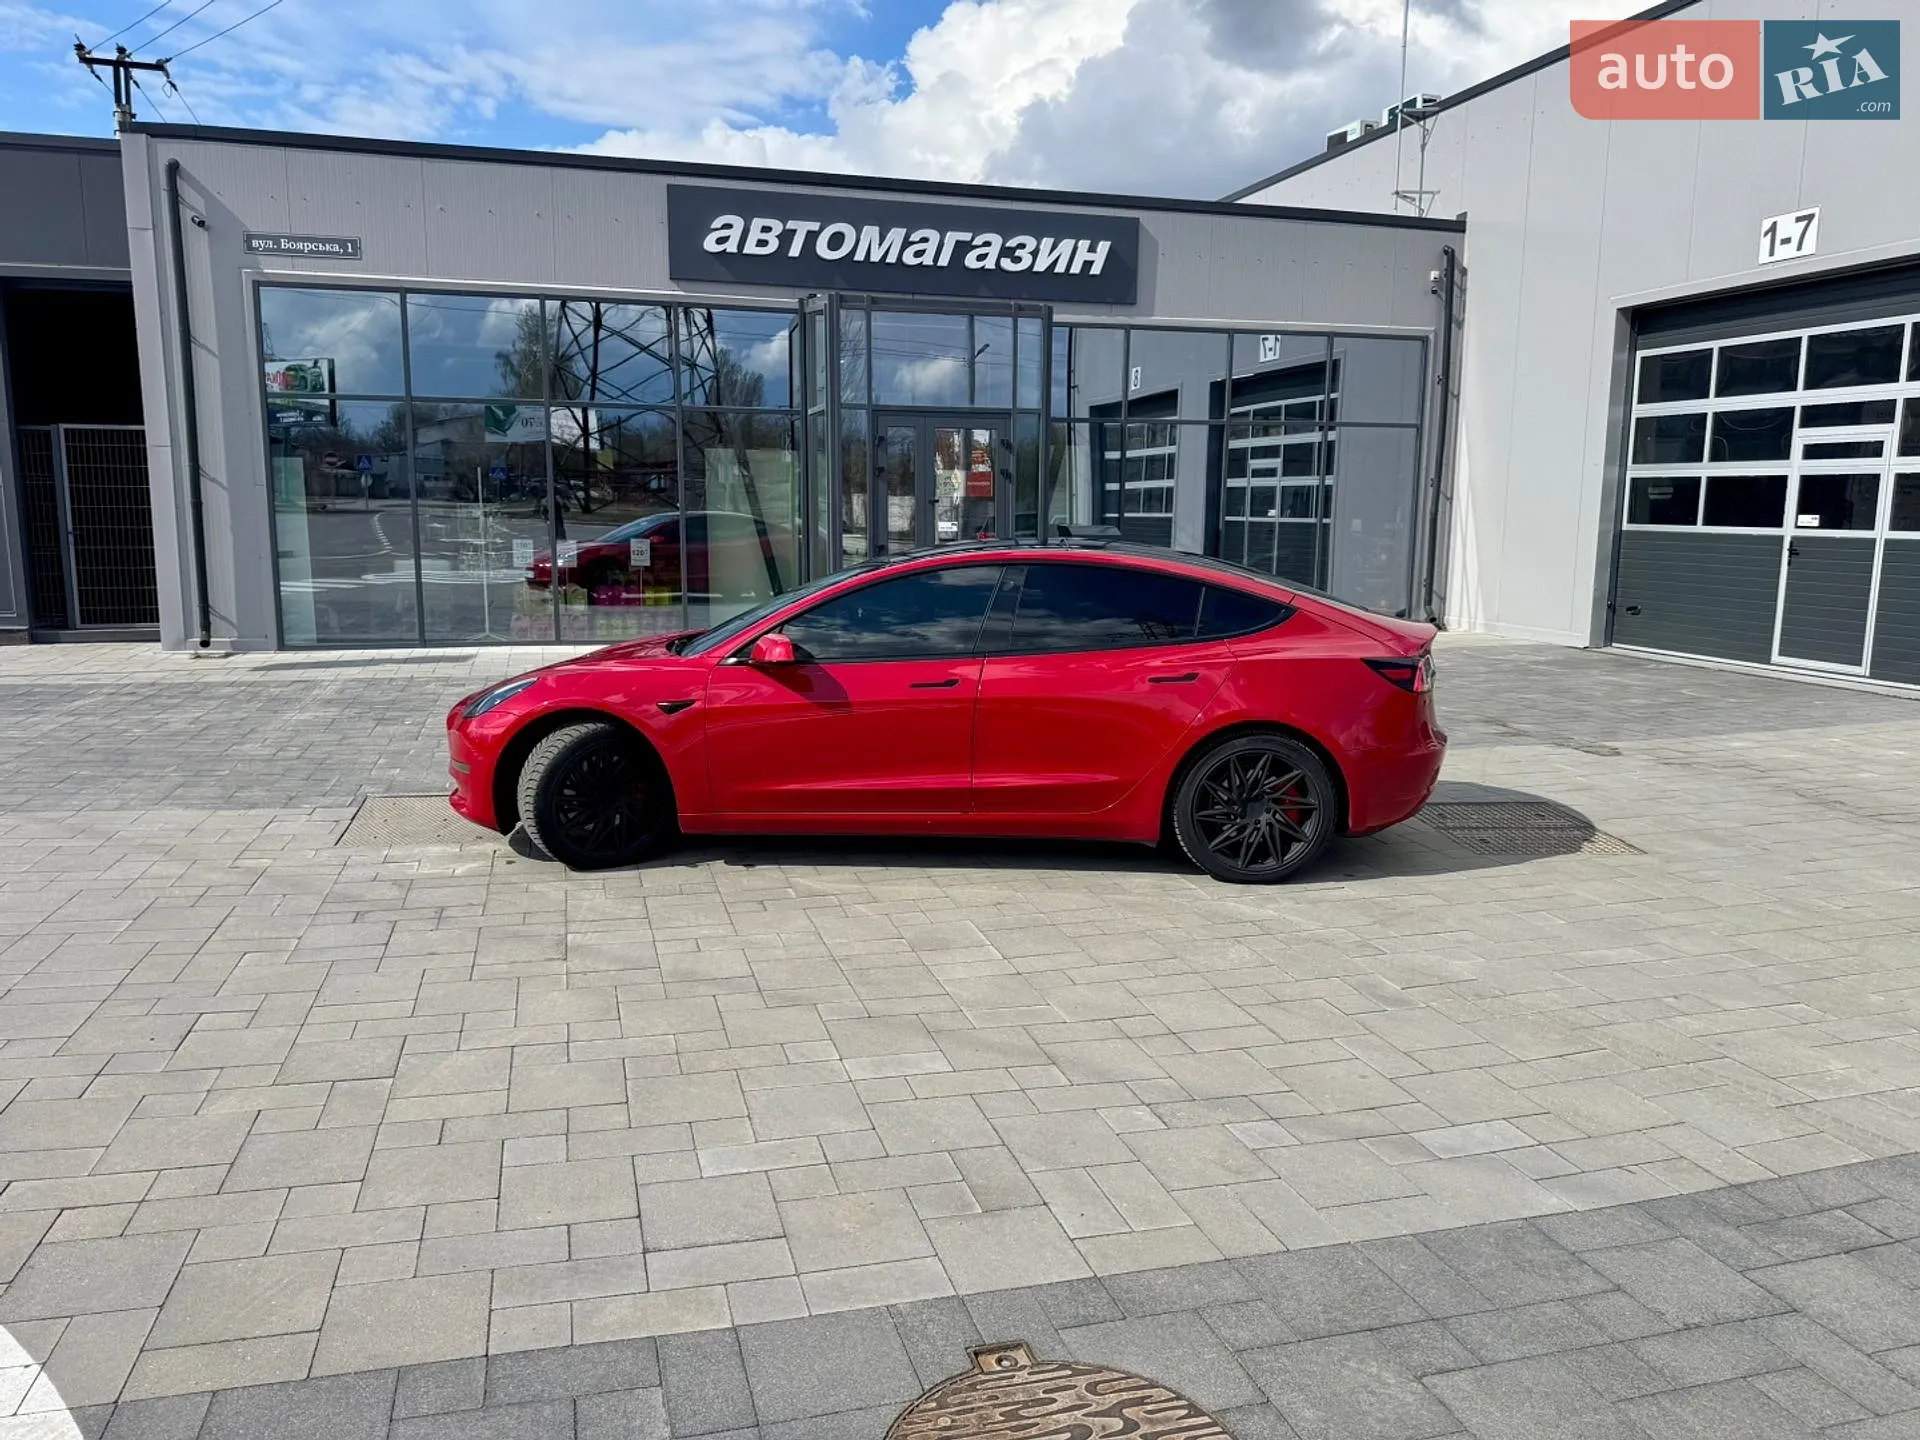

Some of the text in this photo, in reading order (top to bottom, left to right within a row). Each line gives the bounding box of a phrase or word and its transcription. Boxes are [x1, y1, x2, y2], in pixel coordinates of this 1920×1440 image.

[251, 238, 354, 255] вул. Боярська, 1
[702, 213, 1112, 276] автомагазин
[1762, 211, 1817, 258] 1-7
